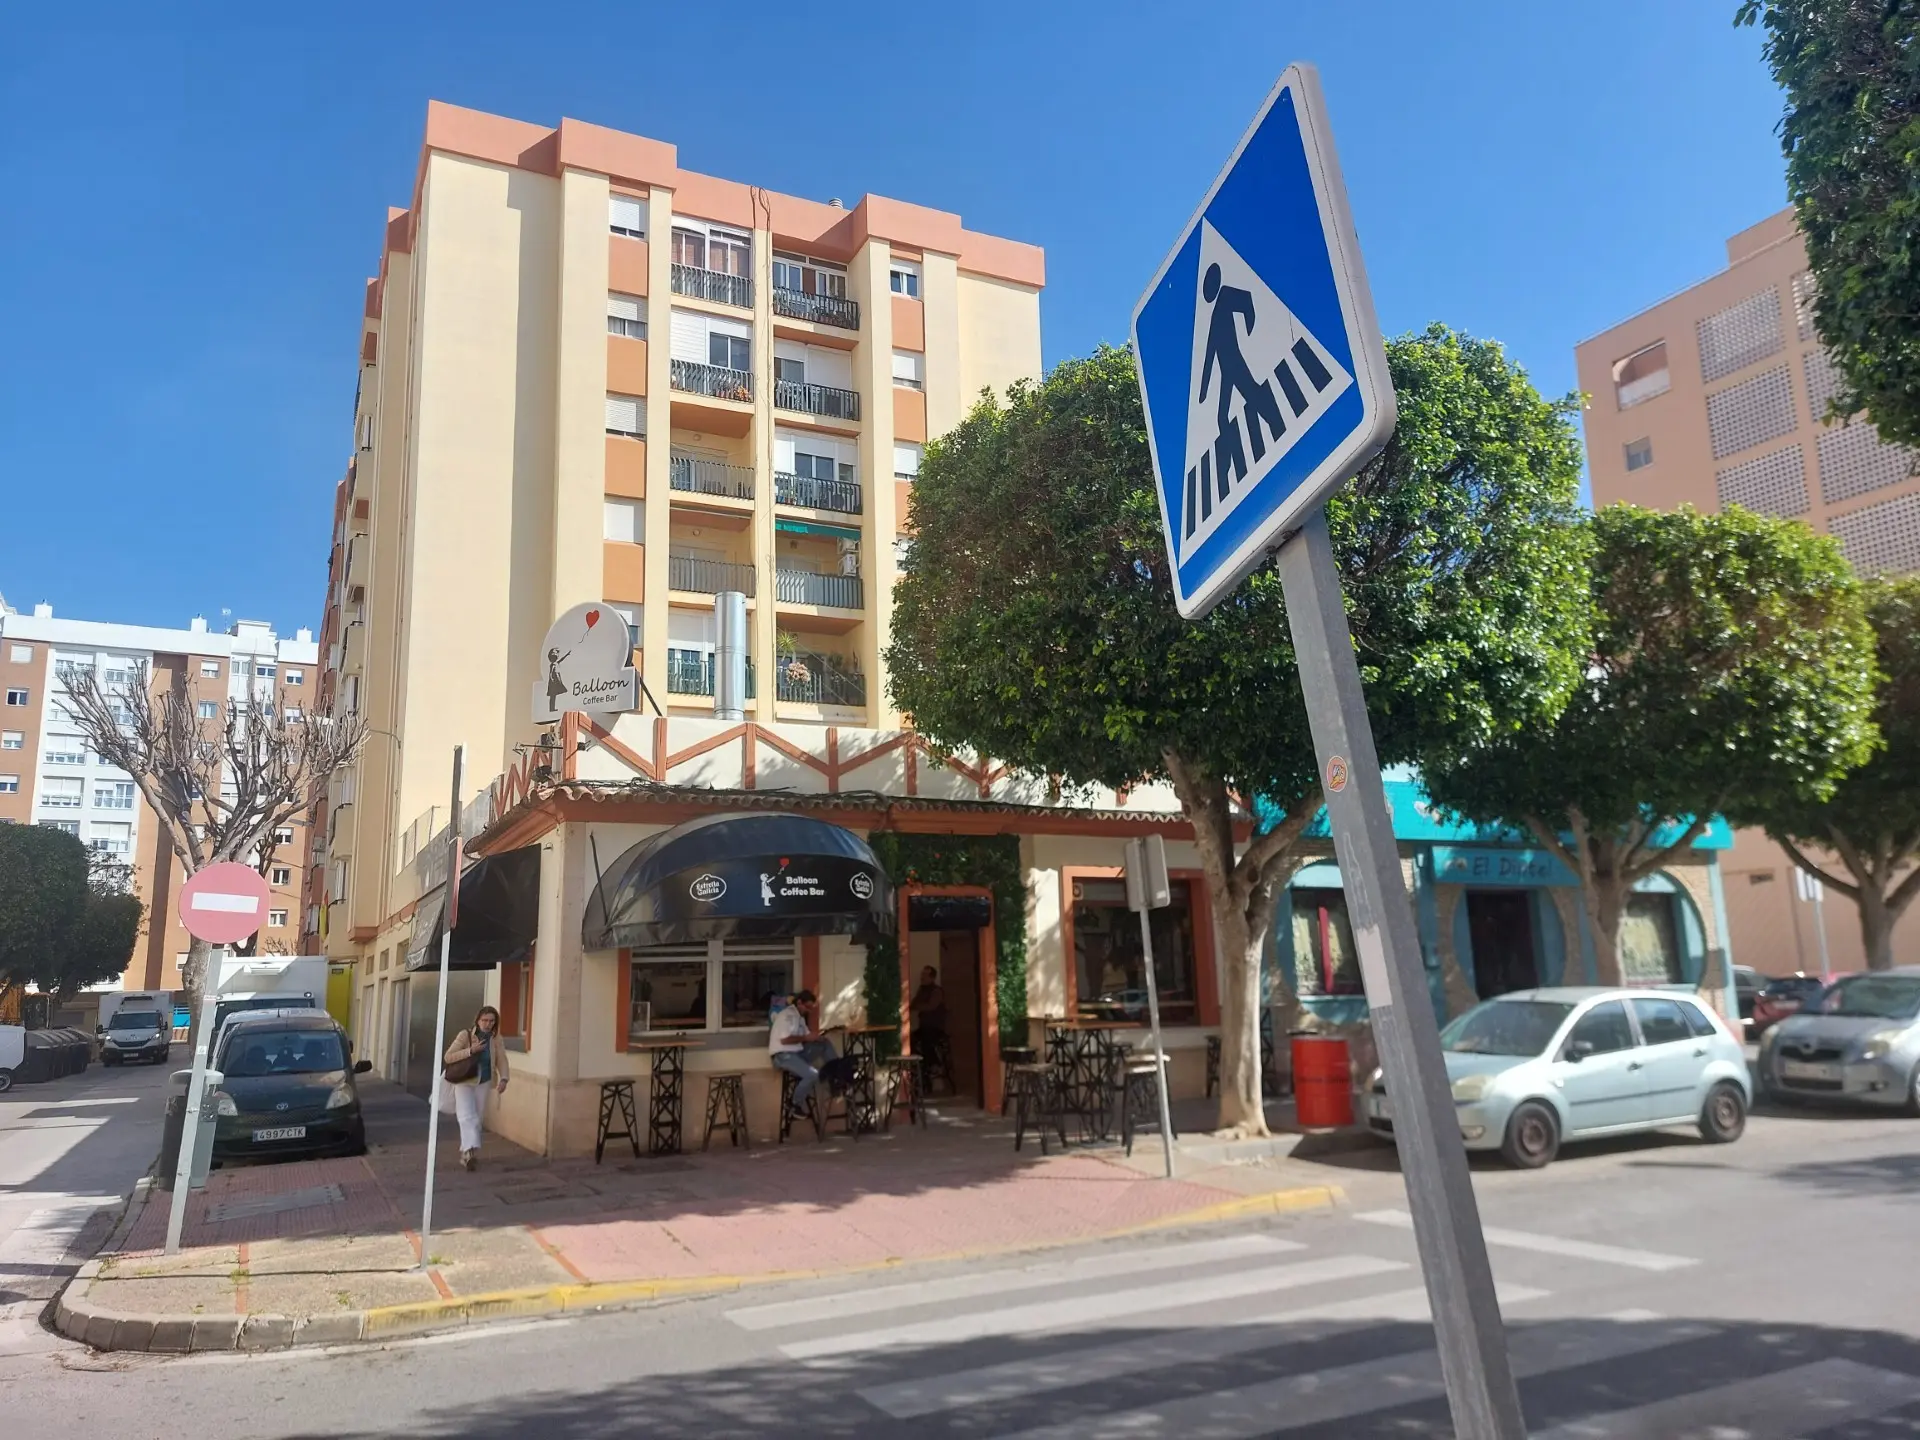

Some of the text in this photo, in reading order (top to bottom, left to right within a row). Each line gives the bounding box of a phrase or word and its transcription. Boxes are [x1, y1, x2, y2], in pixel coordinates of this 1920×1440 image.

[572, 677, 630, 696] Balloon
[583, 694, 618, 706] Coffee Bar
[696, 881, 720, 890] Estrella
[786, 876, 818, 885] Balloon
[780, 887, 825, 897] Coffee Bar
